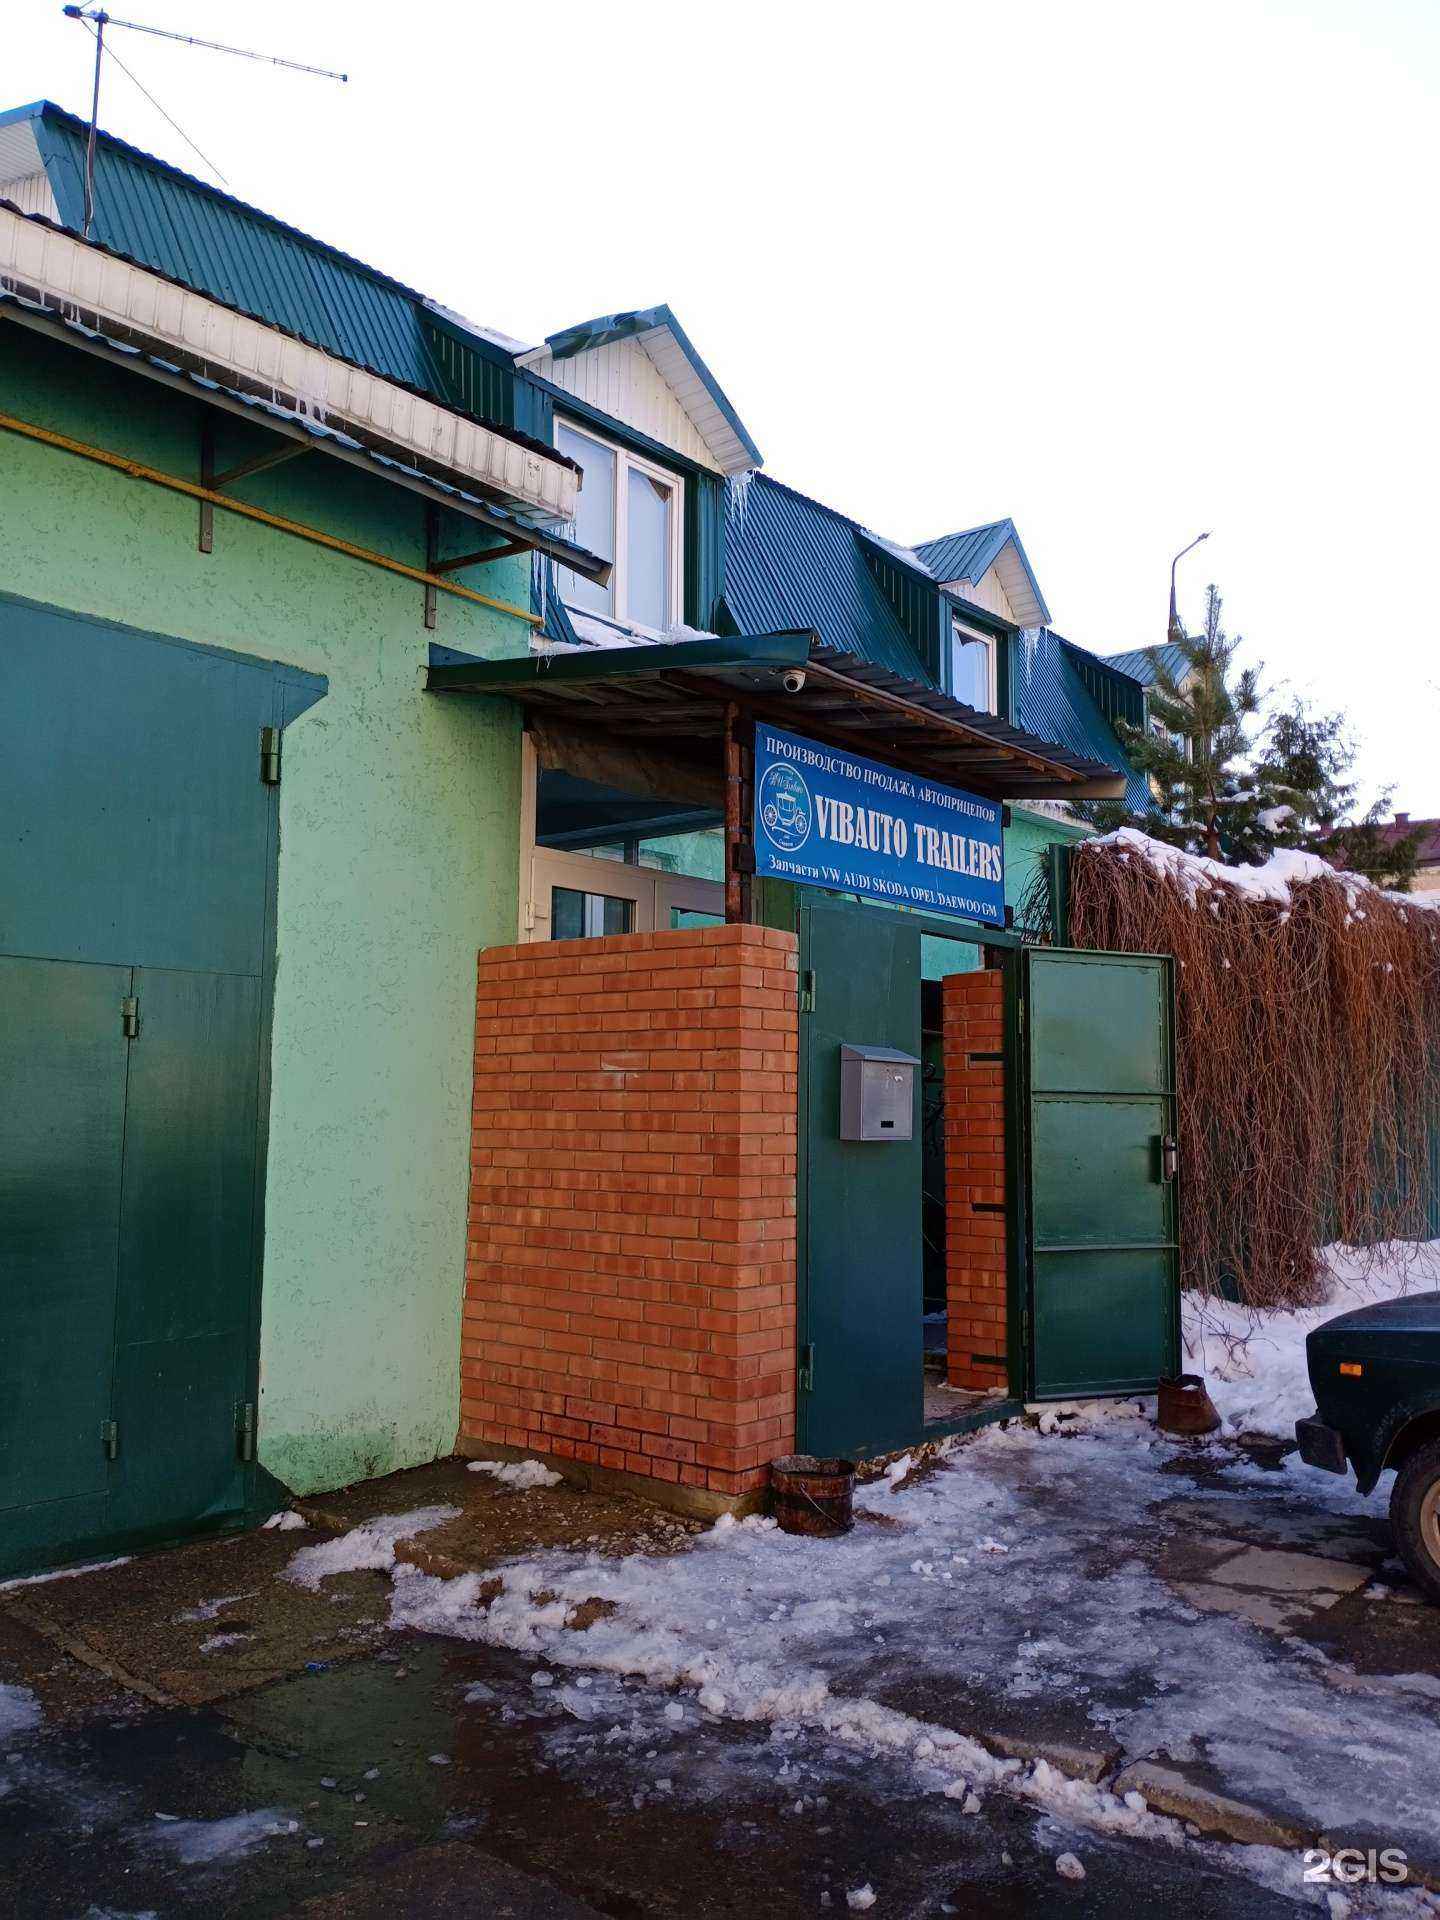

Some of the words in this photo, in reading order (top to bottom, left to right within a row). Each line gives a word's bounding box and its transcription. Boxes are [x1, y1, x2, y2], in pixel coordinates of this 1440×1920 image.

[766, 736, 862, 779] ПРОИЗВОДСТВО
[863, 769, 915, 798] ПРОДАЖА
[918, 787, 996, 823] АВТОПРИЦЕПОВ
[814, 794, 908, 858] VIBAUTO
[914, 823, 1002, 883] TRAILERS
[768, 854, 819, 879] Запчасти
[821, 865, 841, 883] VW
[843, 871, 871, 890] AUDI
[873, 877, 910, 899] SKODA
[911, 886, 938, 905] OPEL
[937, 892, 981, 914] DAEWOO
[982, 902, 998, 918] GM
